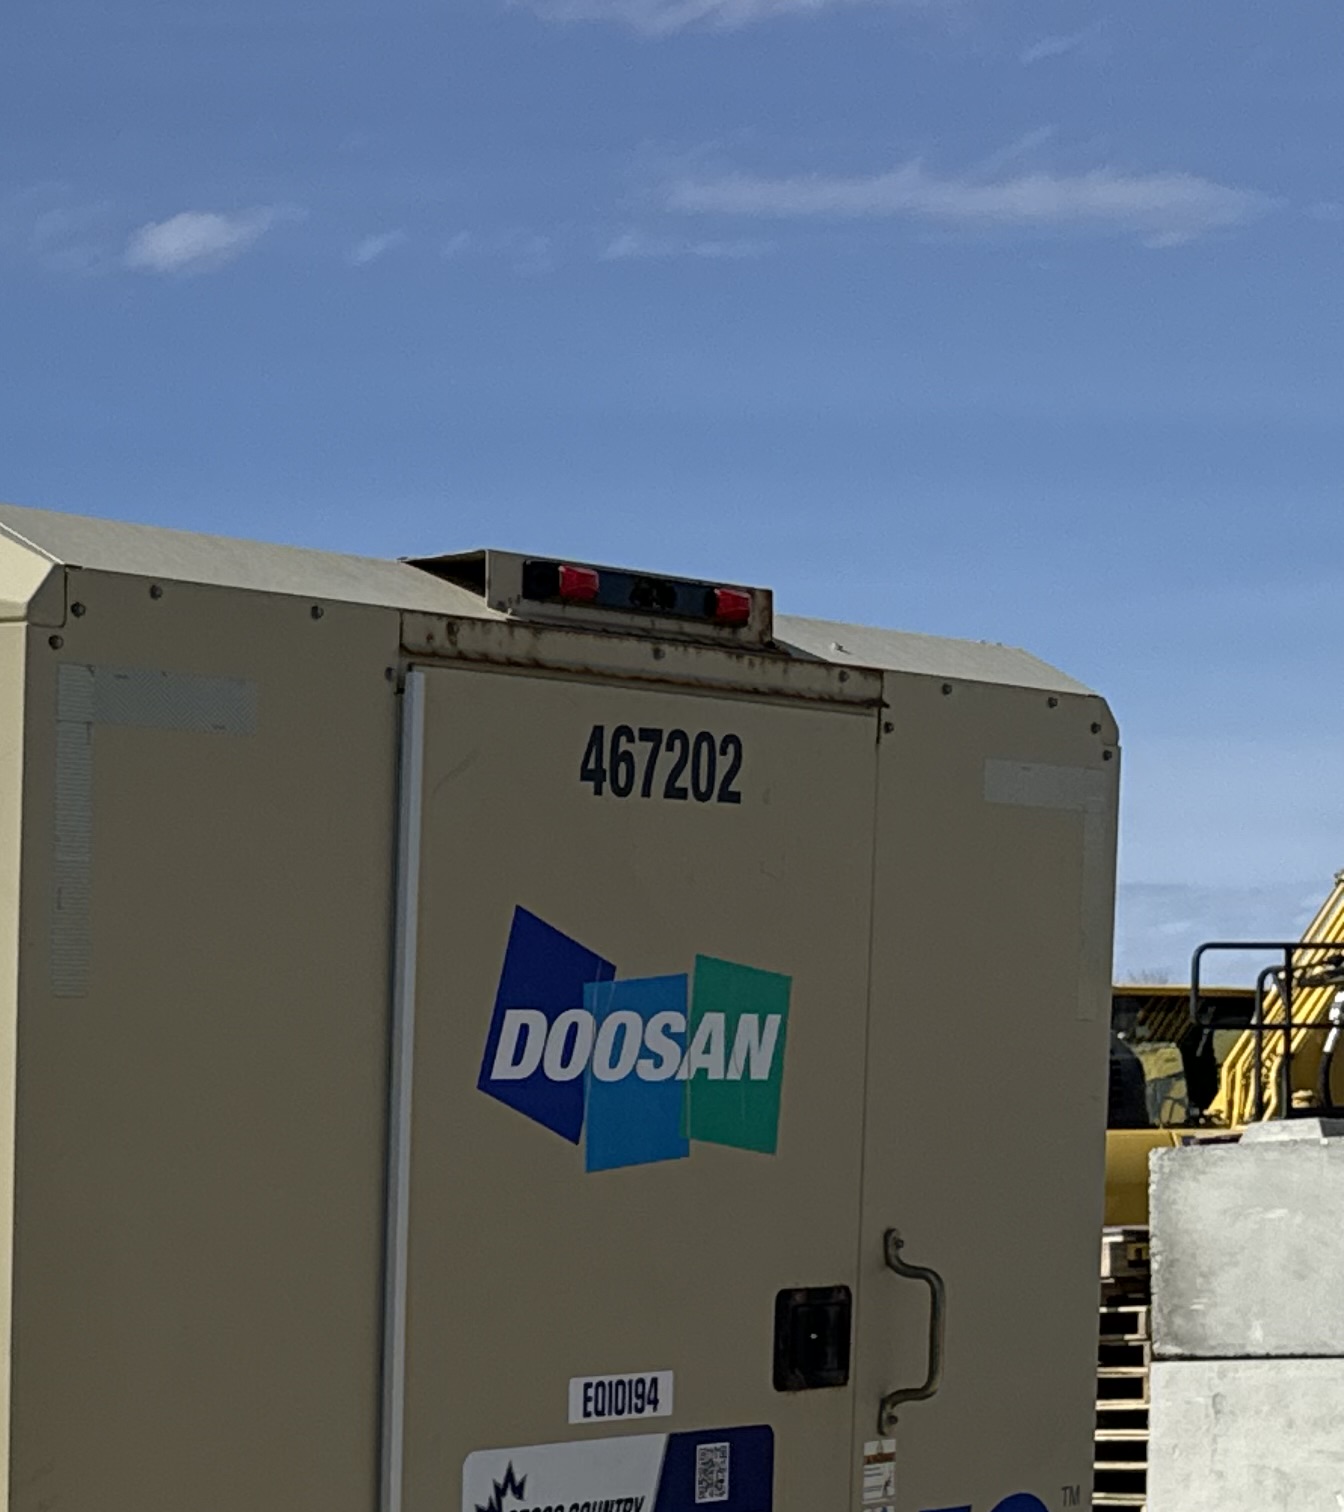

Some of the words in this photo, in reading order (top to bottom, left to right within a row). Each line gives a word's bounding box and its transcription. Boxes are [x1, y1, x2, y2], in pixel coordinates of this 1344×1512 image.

[579, 724, 743, 804] 467202
[490, 1008, 781, 1082] DOOSAN
[582, 1376, 660, 1419] EQ10194
[1061, 1485, 1081, 1508] TM
